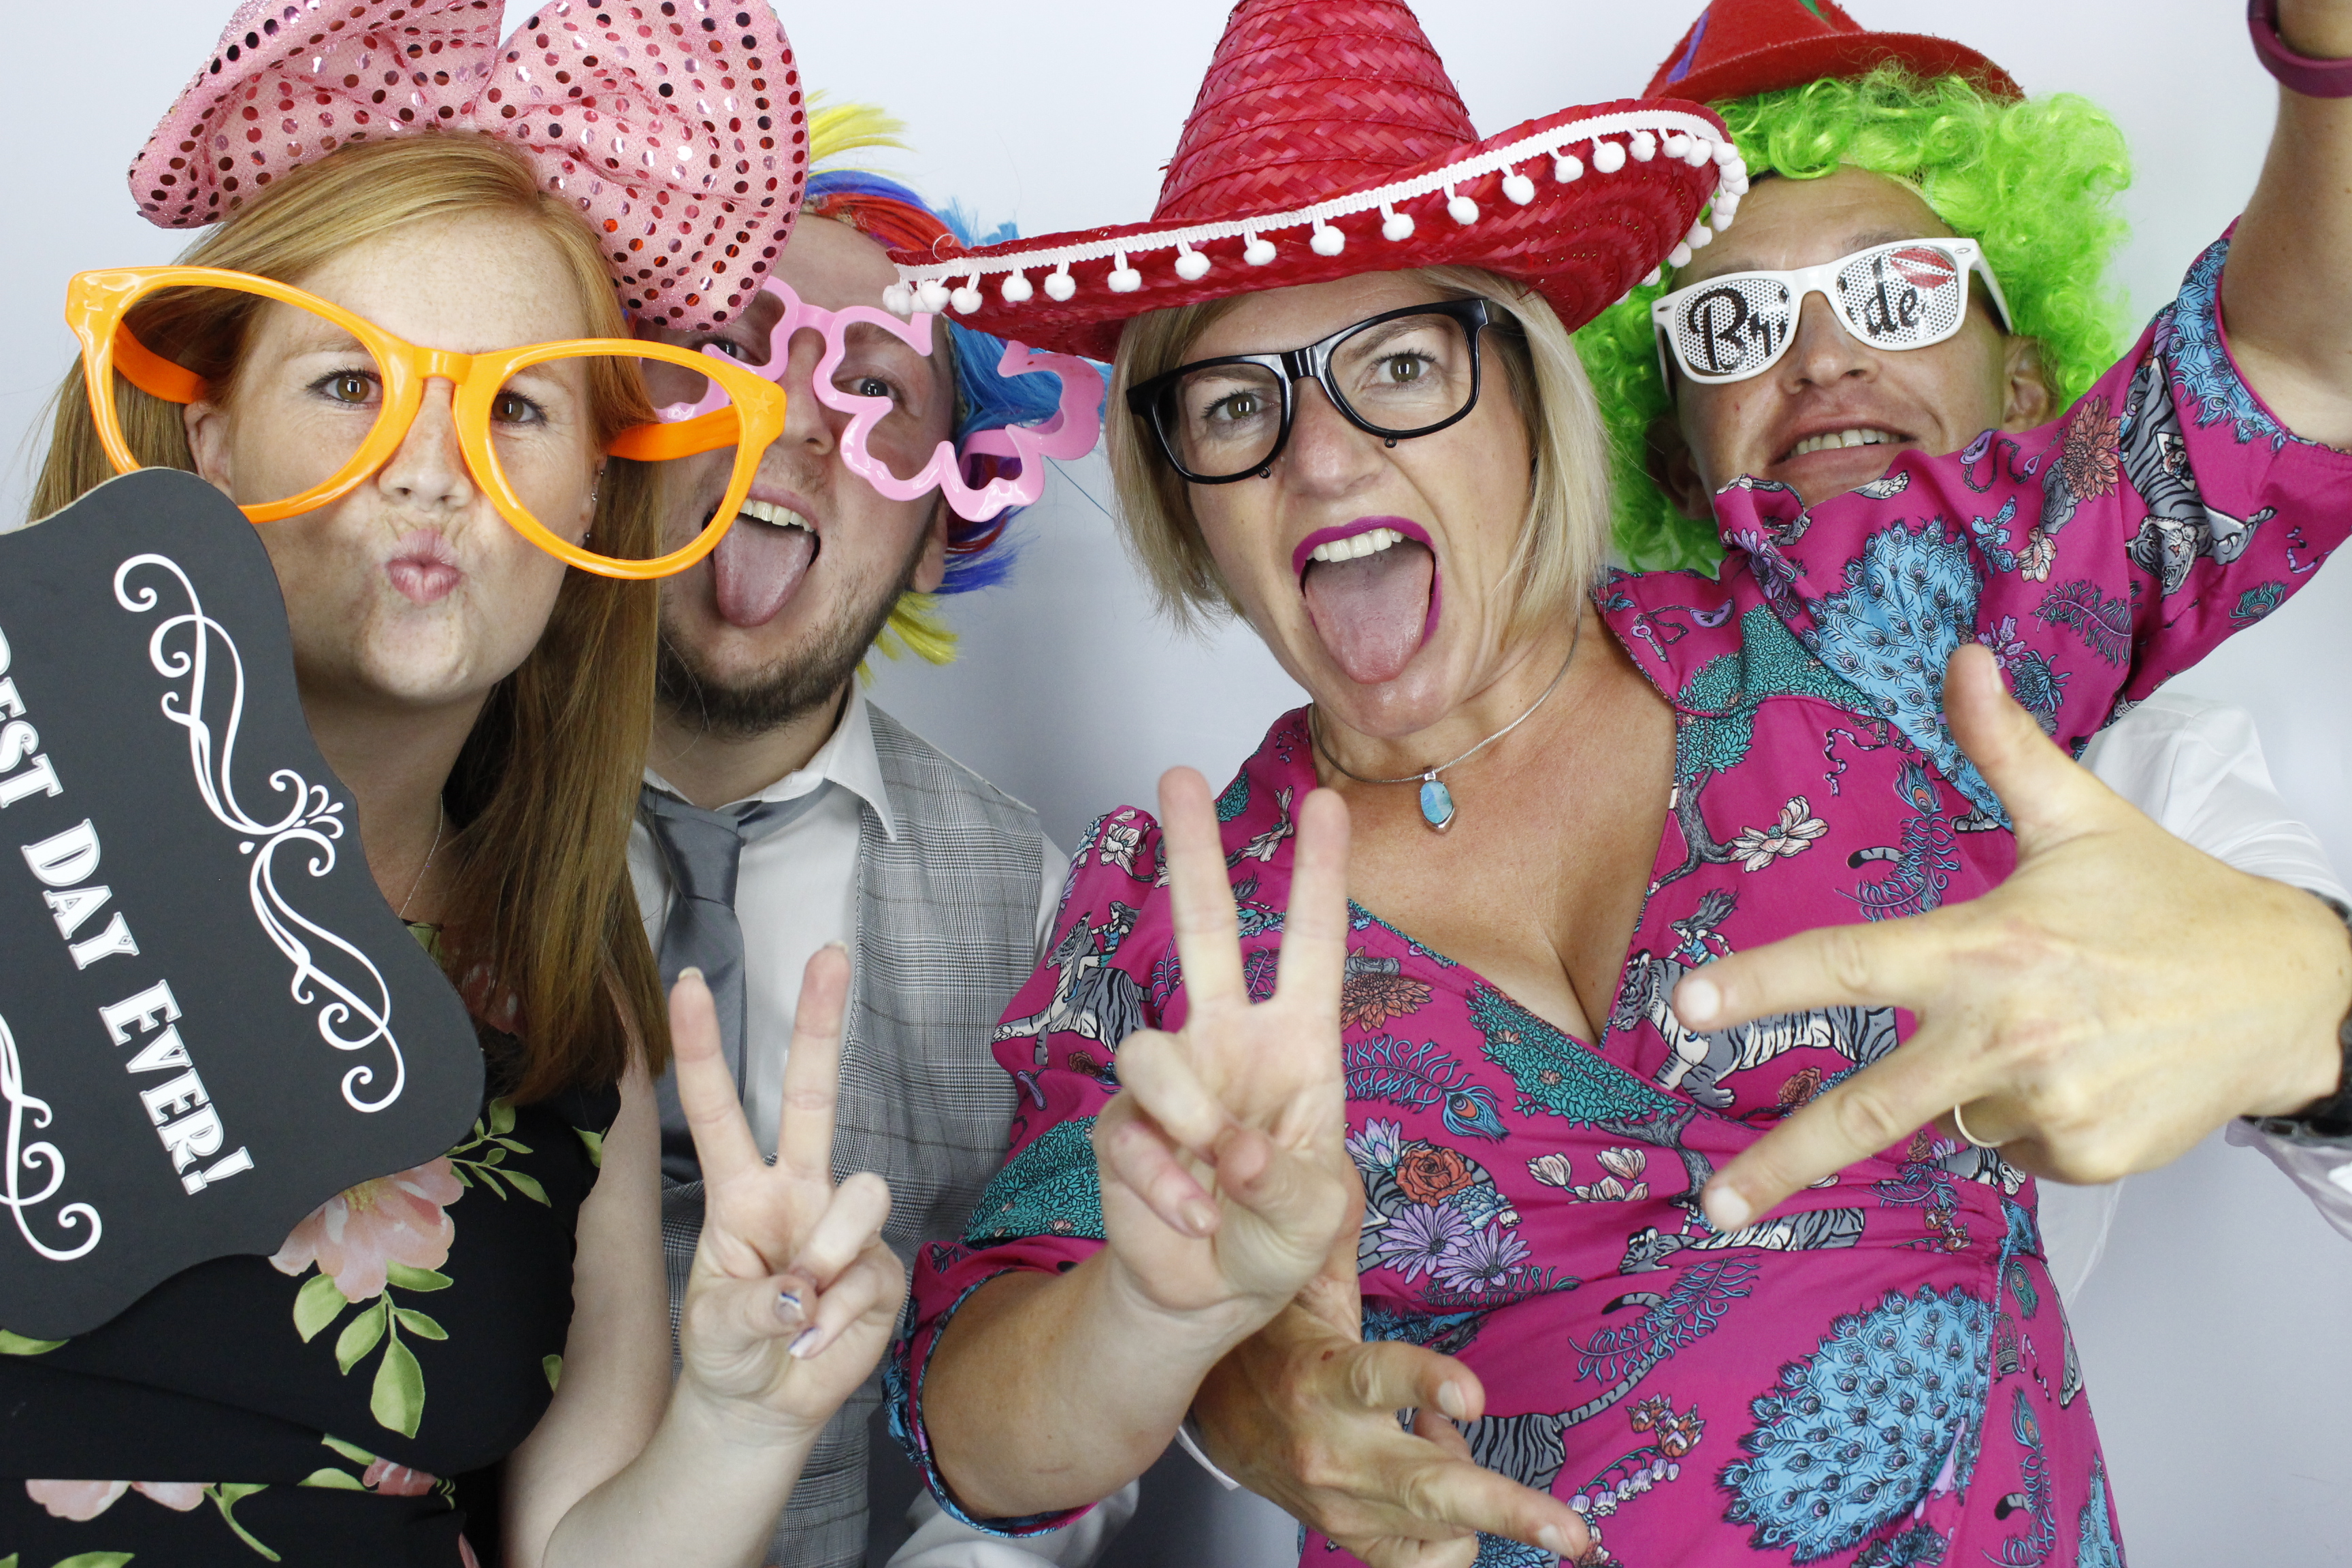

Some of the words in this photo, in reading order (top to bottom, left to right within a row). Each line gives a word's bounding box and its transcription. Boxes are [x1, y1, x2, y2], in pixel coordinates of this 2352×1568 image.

[0, 625, 64, 808] ST
[20, 817, 140, 970] DAY
[98, 978, 255, 1196] EVER!
